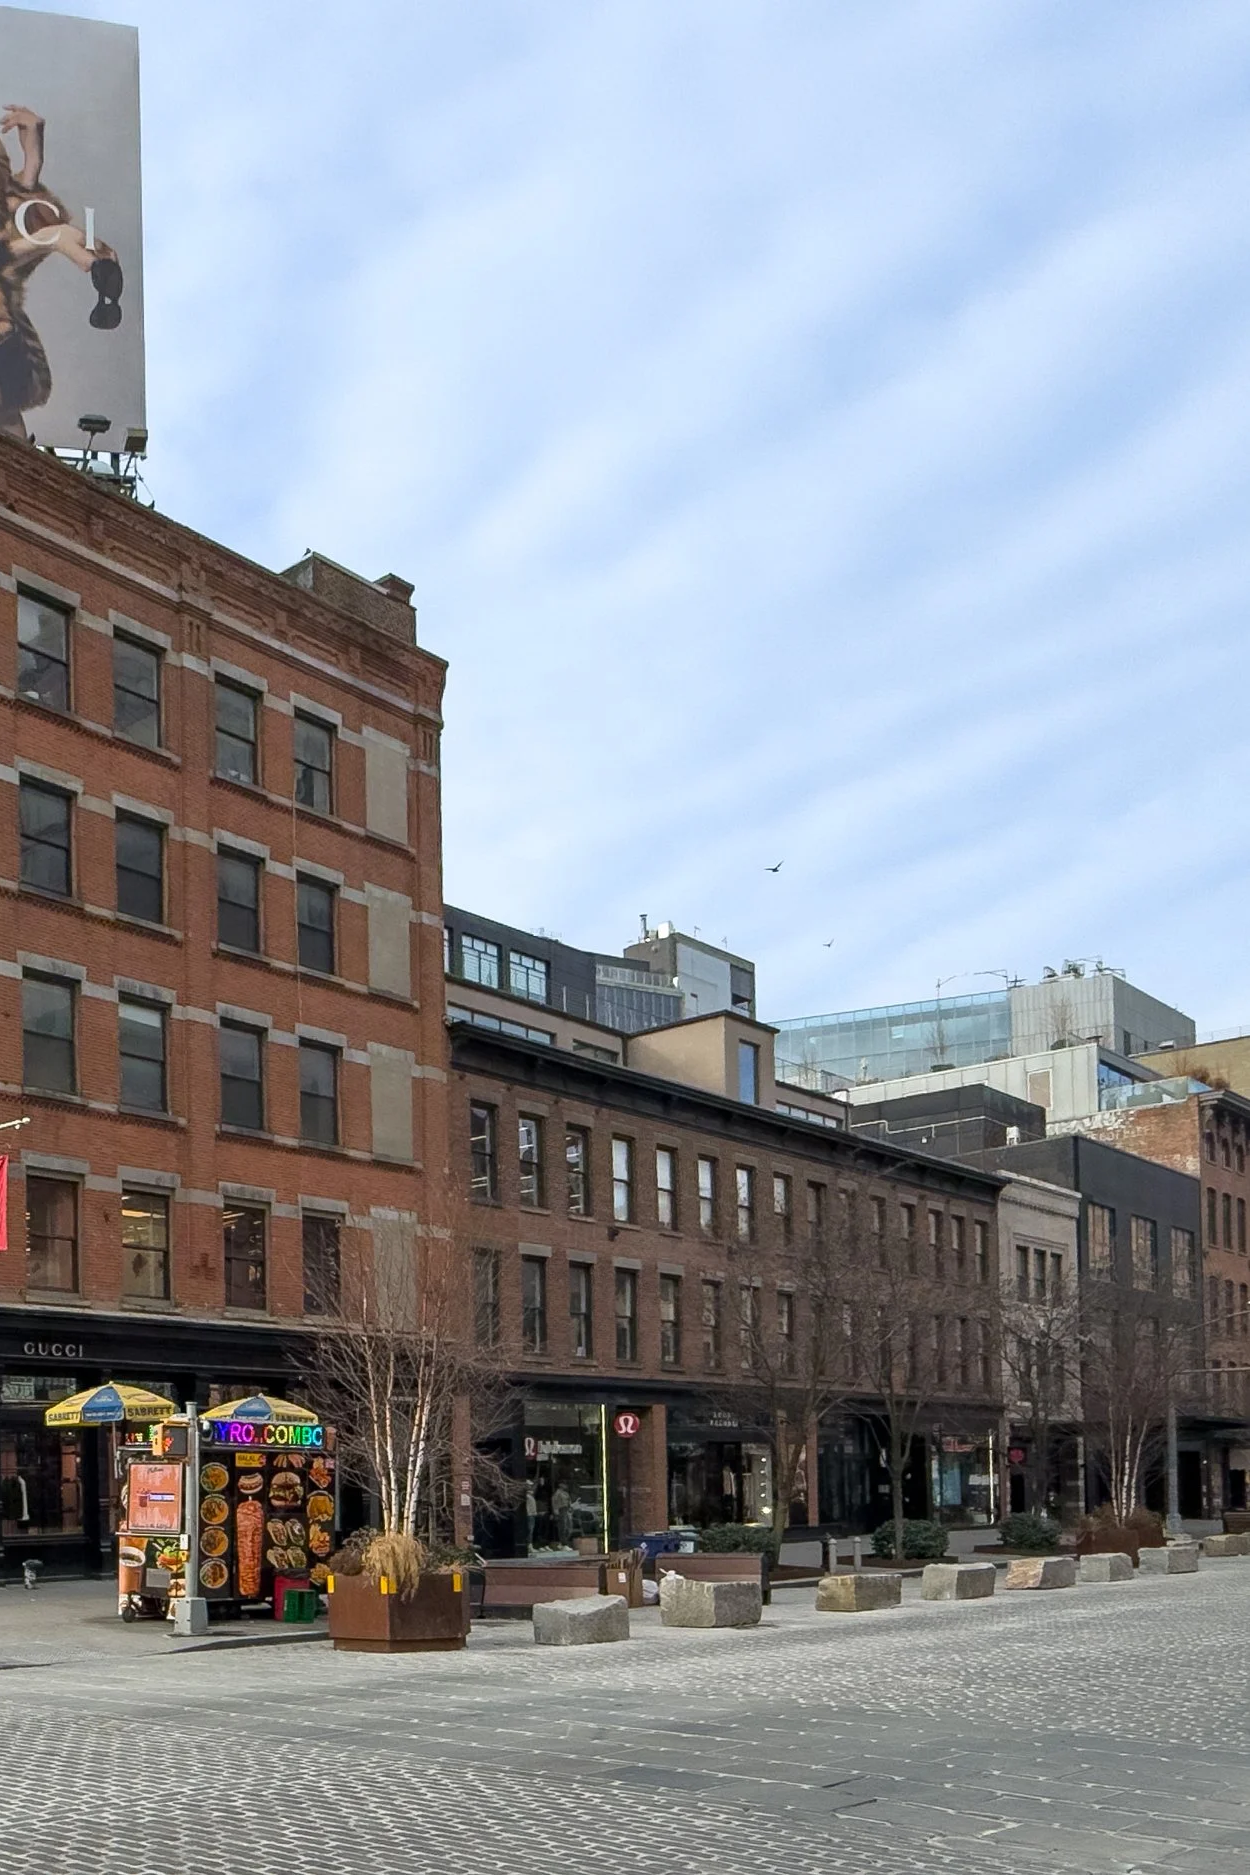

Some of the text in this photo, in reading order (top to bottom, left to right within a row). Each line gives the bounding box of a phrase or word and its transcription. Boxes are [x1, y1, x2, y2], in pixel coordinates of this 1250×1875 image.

[23, 1341, 83, 1358] GUCCI
[47, 1411, 79, 1422] SABRETT
[127, 1406, 172, 1417] SABRETT
